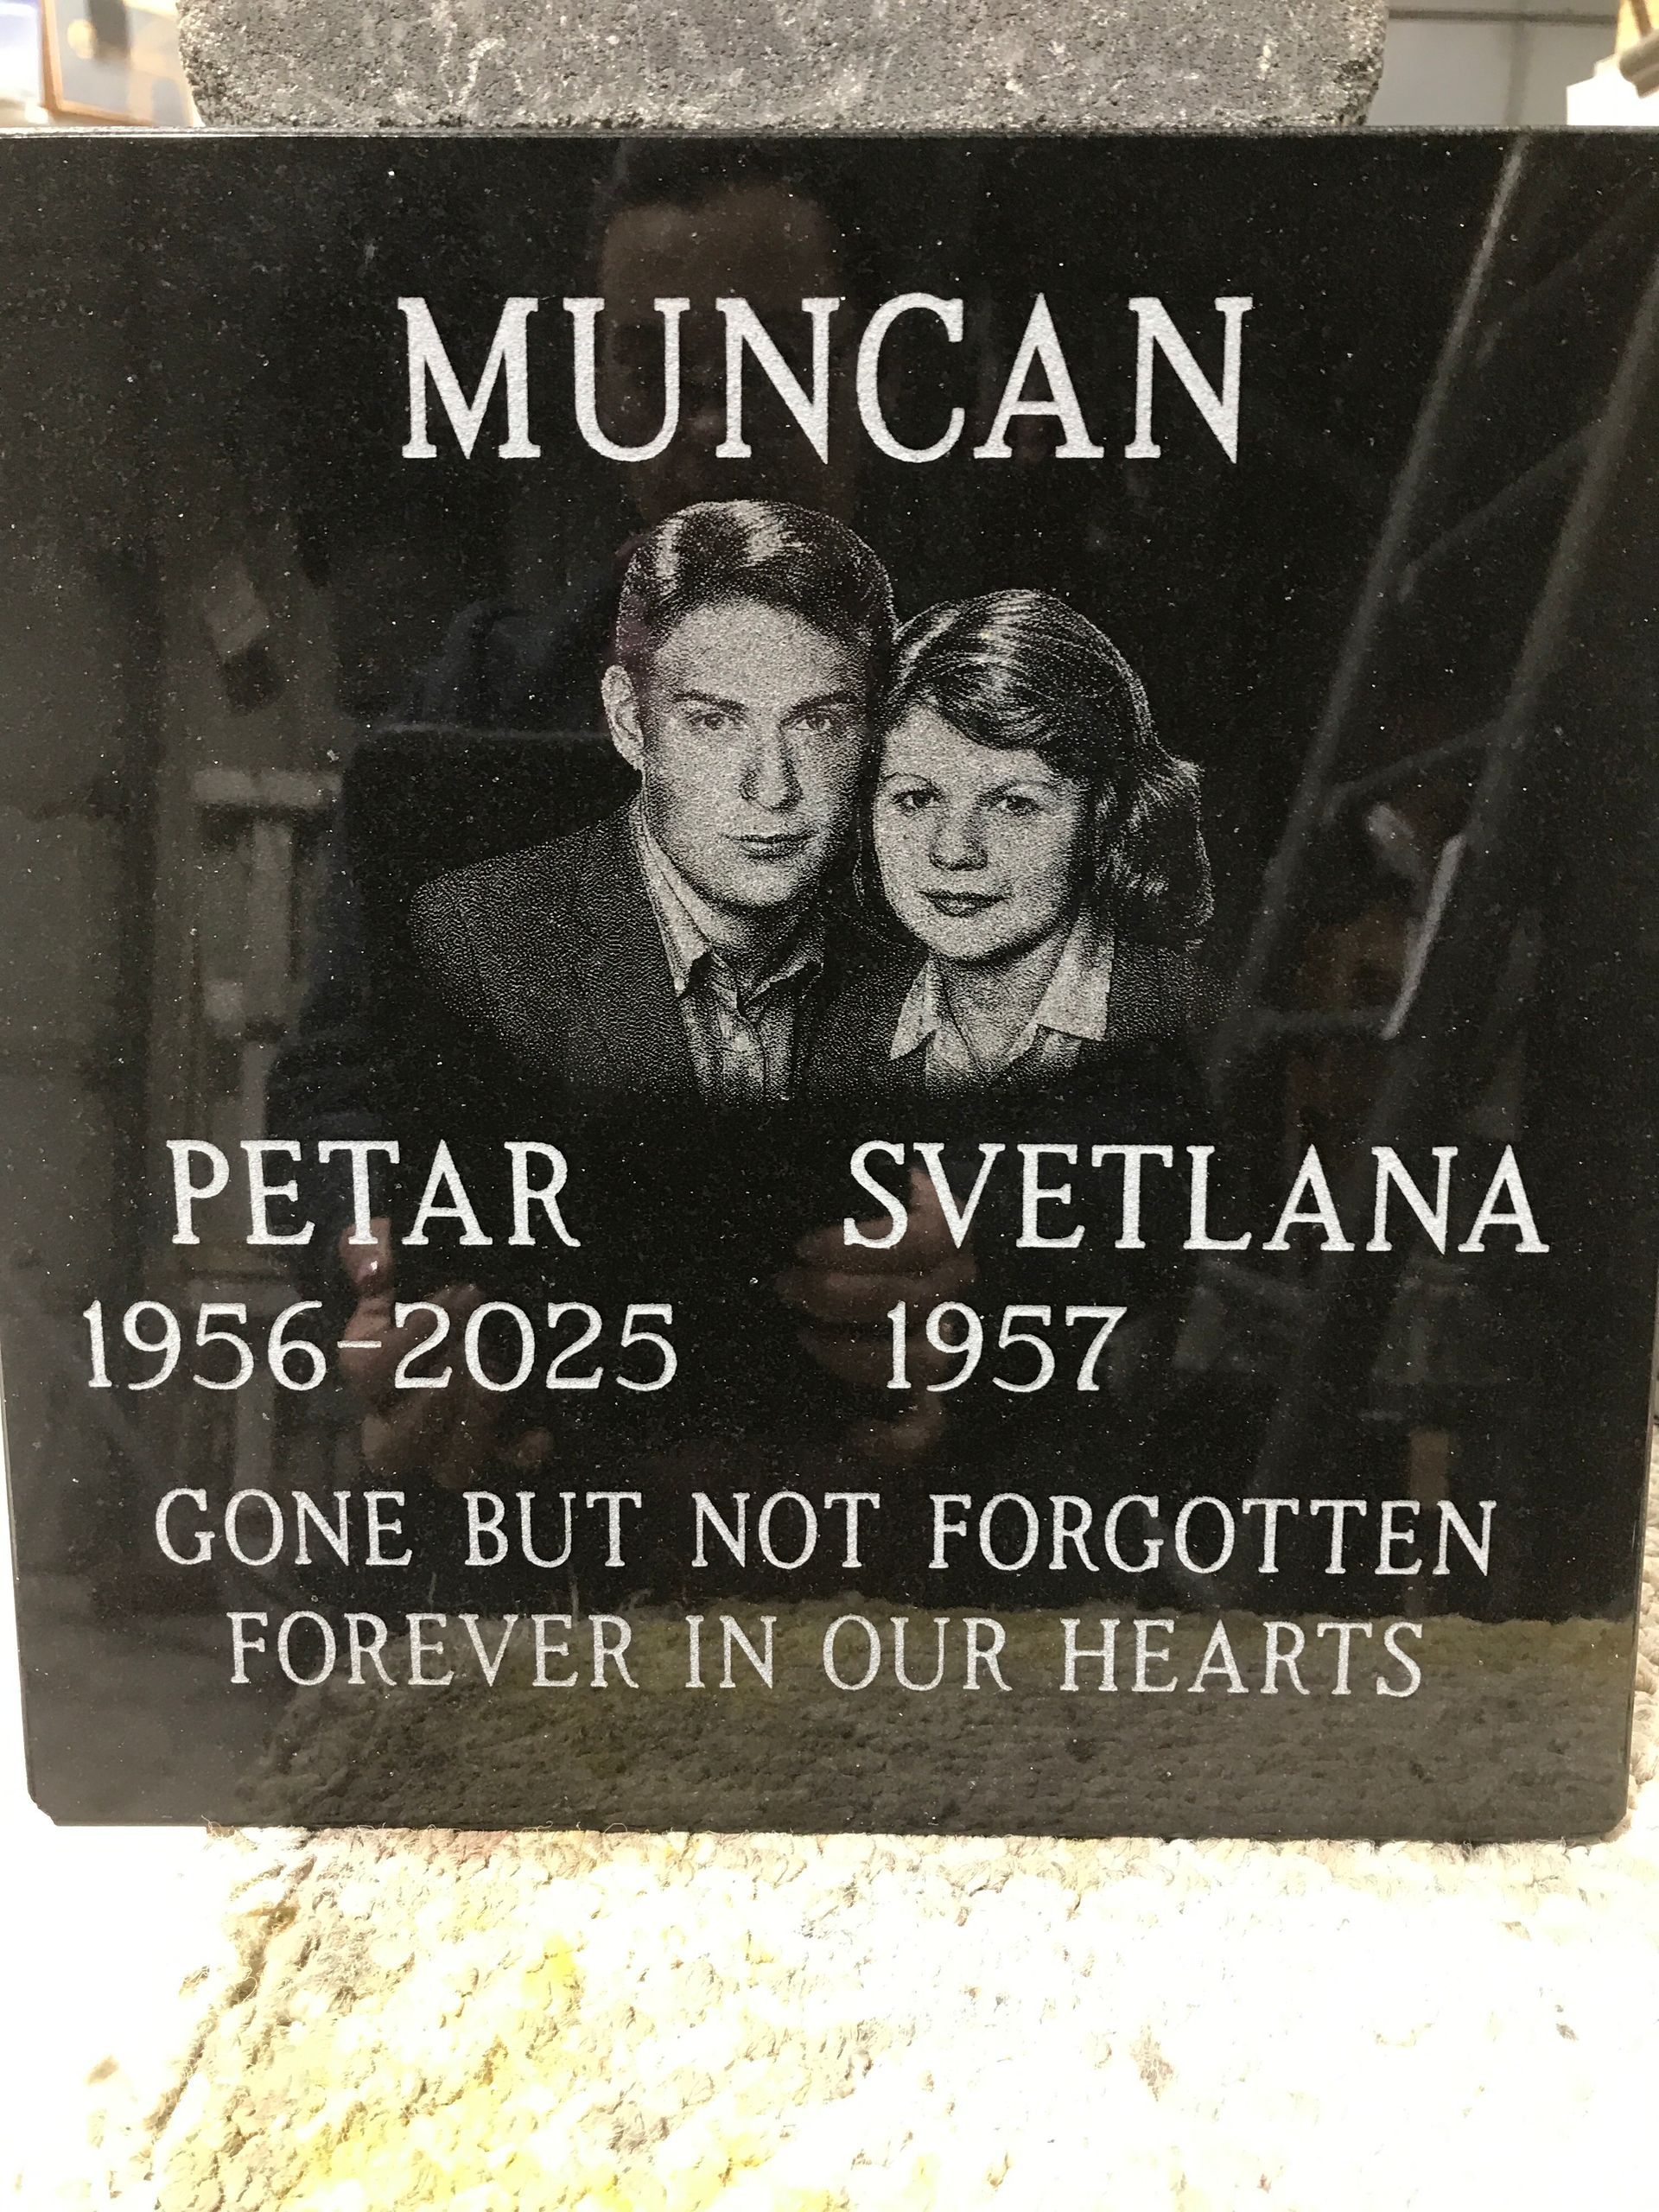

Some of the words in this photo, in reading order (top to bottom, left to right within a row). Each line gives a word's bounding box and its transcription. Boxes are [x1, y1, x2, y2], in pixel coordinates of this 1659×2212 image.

[398, 293, 1252, 463] MUNCAN
[167, 1141, 580, 1248] PETAR
[844, 1141, 1549, 1253] SVETLANA
[84, 1300, 677, 1392] 1956-2025
[888, 1302, 1127, 1392] 1957
[156, 1489, 412, 1567] GONE
[463, 1491, 642, 1568] BUT
[692, 1492, 880, 1570] NOT
[930, 1494, 1497, 1575] FORGOTTEN
[227, 1611, 639, 1688] FOREVER
[685, 1615, 777, 1689] IN
[823, 1614, 1012, 1692] OUR
[1060, 1619, 1423, 1698] HEARTS
